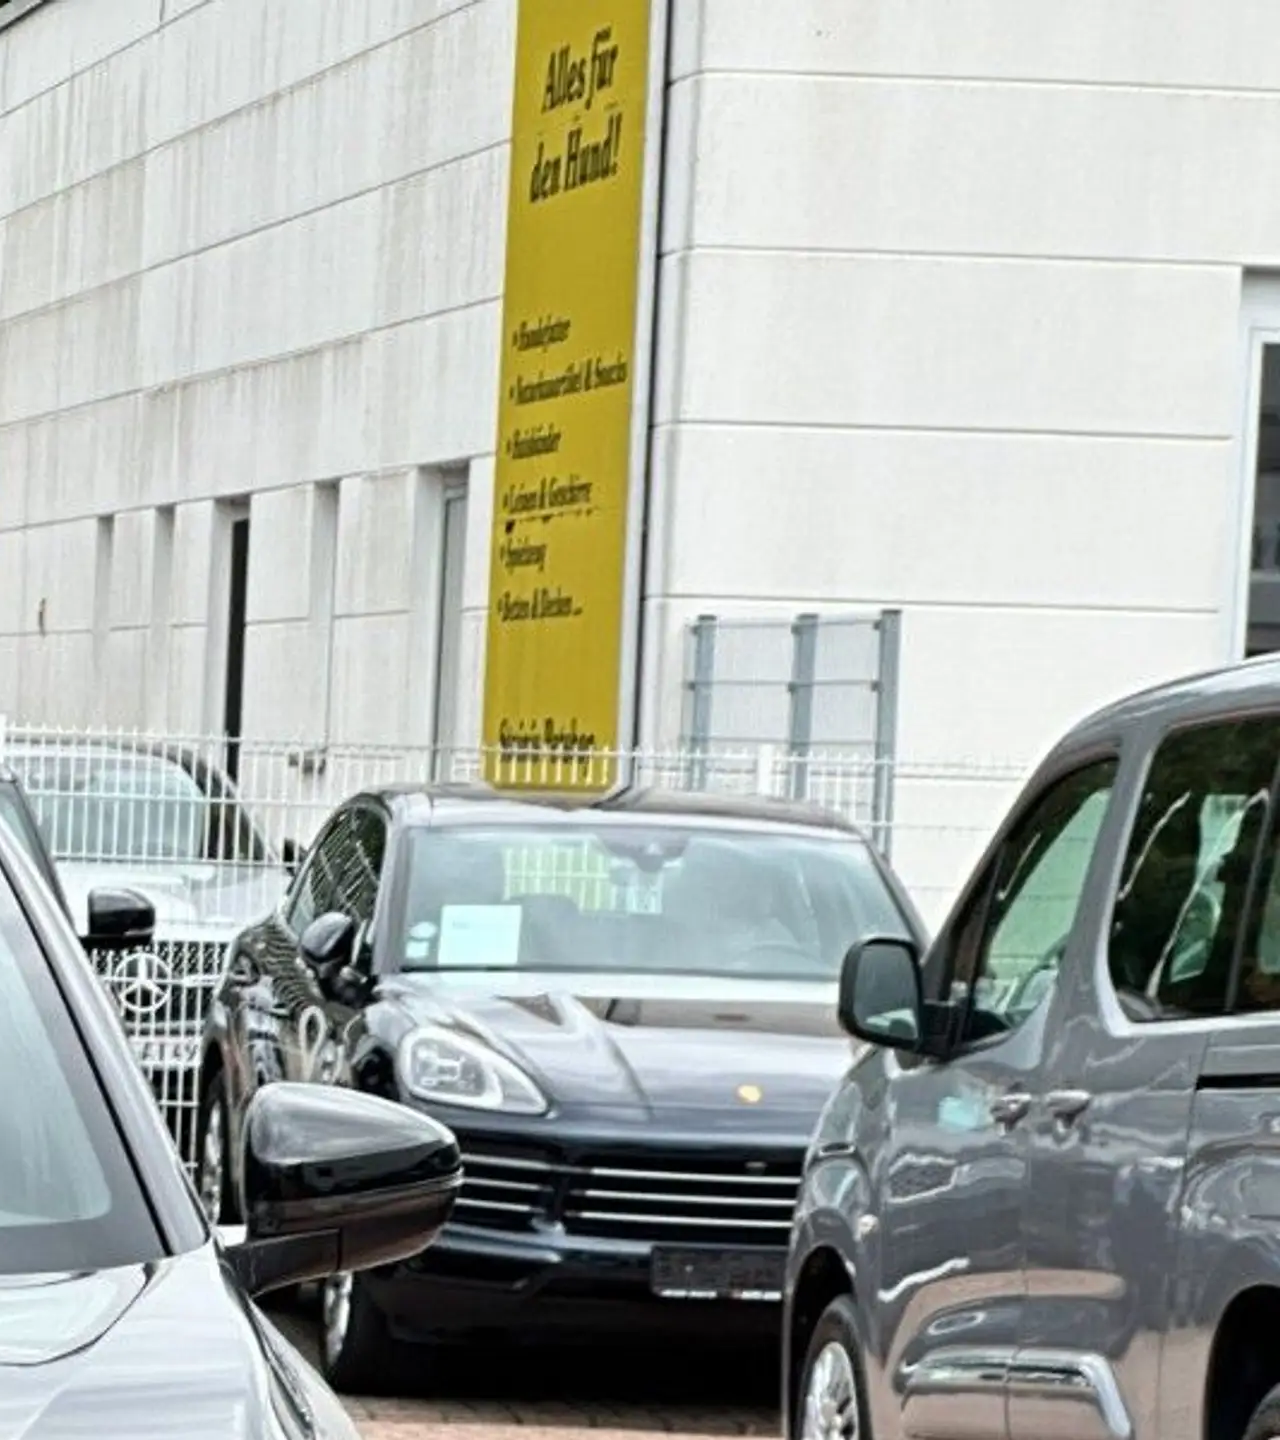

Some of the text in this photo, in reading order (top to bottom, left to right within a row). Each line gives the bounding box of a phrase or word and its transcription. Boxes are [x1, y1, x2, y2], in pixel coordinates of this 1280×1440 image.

[541, 43, 587, 114] Alles
[529, 112, 623, 203] den Hund!
